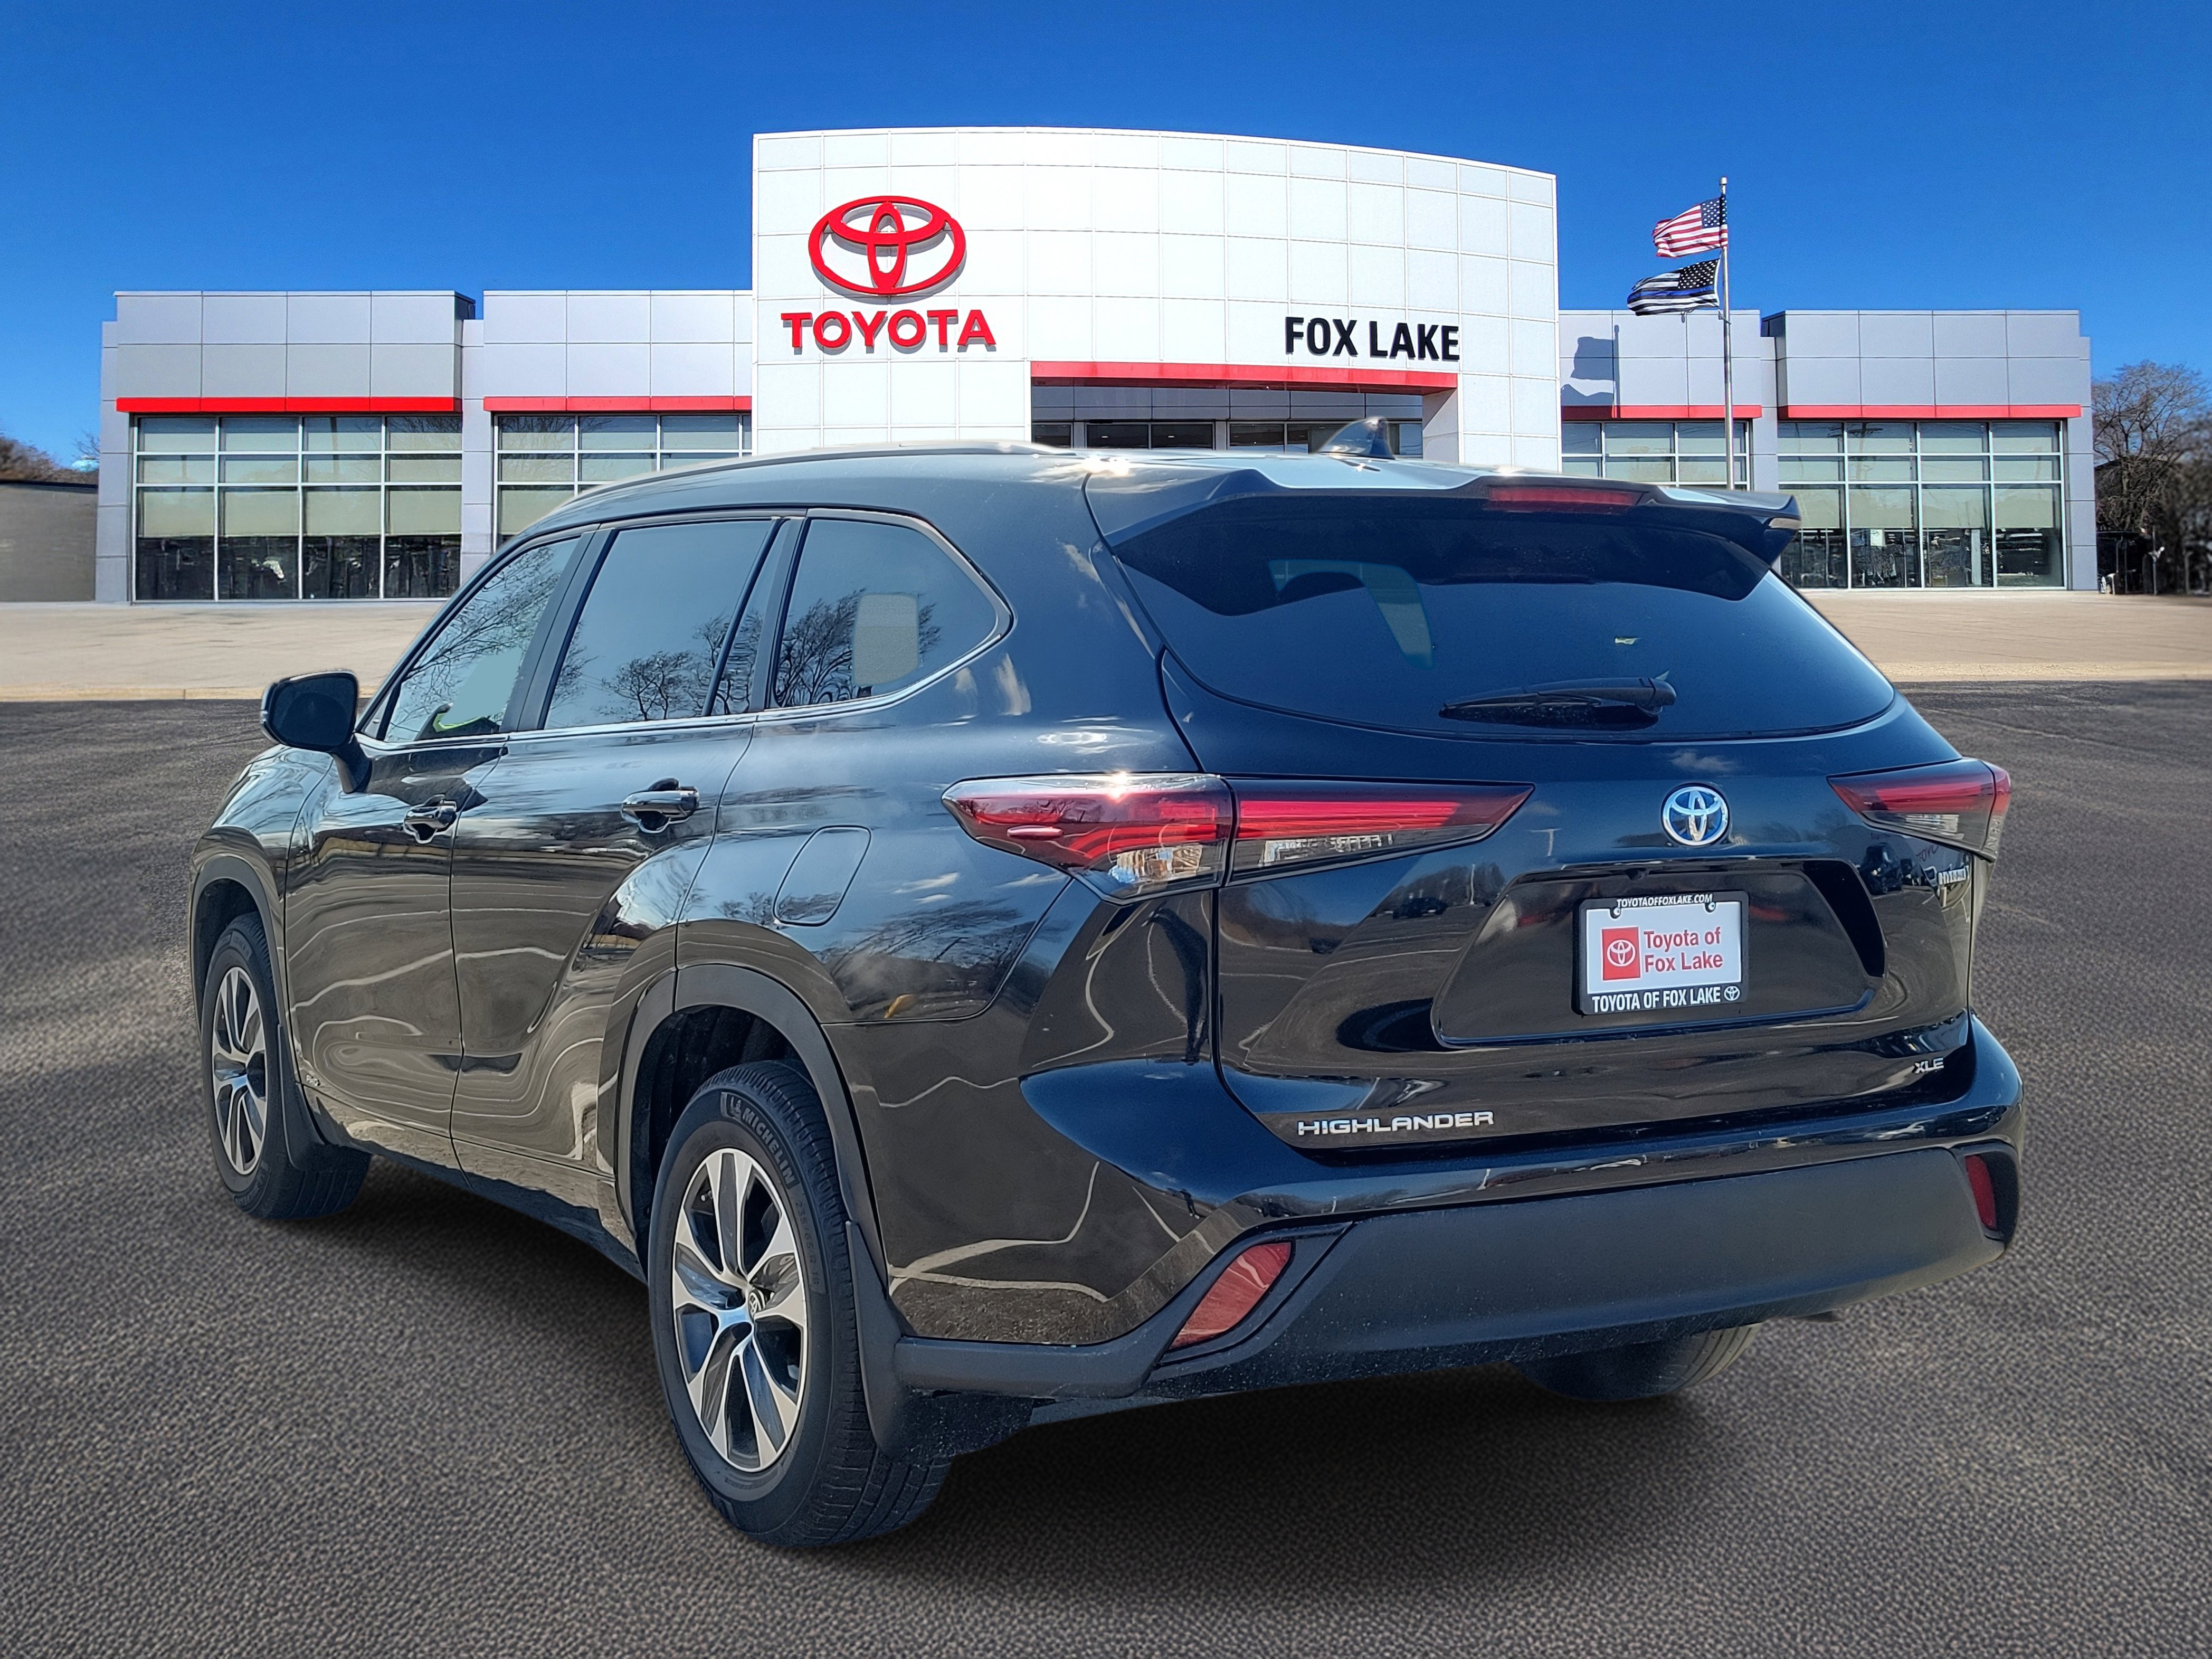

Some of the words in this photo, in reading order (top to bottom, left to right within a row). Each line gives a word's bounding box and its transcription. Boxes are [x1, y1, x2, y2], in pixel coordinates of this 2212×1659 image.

[781, 309, 996, 349] TOYOTA
[1285, 317, 1358, 357] FOX
[1369, 321, 1460, 361] LAKE
[1616, 894, 1713, 908] TOYOTAOFFOXLAKE.COM
[1644, 929, 1699, 952] Toyota
[1704, 926, 1721, 945] of
[1644, 954, 1676, 972] Fox
[1681, 951, 1723, 970] Lake
[1592, 993, 1640, 1012] TOYOTA
[1643, 991, 1660, 1009] OF
[1663, 989, 1687, 1007] FOX
[1690, 987, 1721, 1004] LAKE
[1914, 1057, 1944, 1074] XLE
[1297, 1111, 1494, 1135] HIGHLANDER
[742, 1107, 795, 1184] MICHELIN
